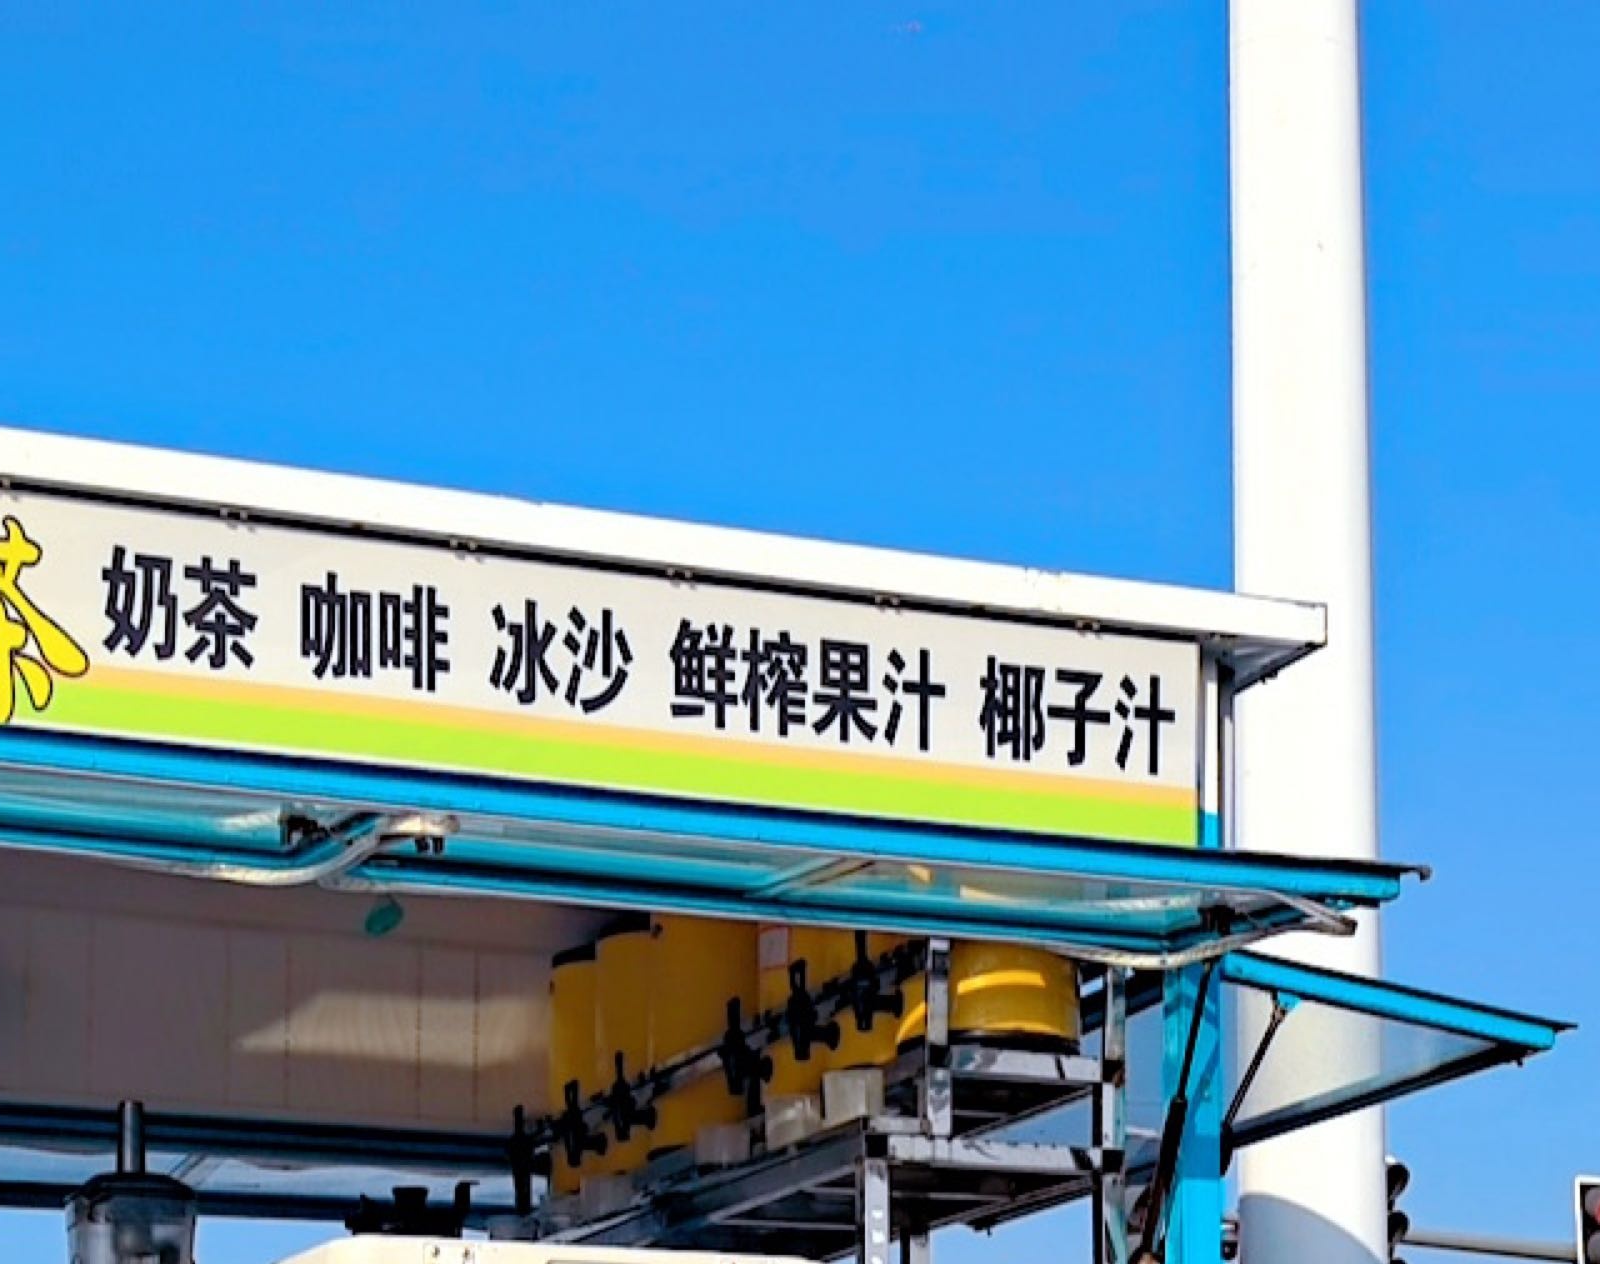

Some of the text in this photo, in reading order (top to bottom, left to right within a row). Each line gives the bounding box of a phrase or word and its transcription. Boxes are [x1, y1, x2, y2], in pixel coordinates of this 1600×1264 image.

[101, 545, 258, 670] 奶茶
[299, 571, 451, 692] 咖啡
[489, 600, 634, 715] 冰沙
[668, 618, 946, 751] 鲜榨果汁
[978, 655, 1176, 776] 椰子汁
